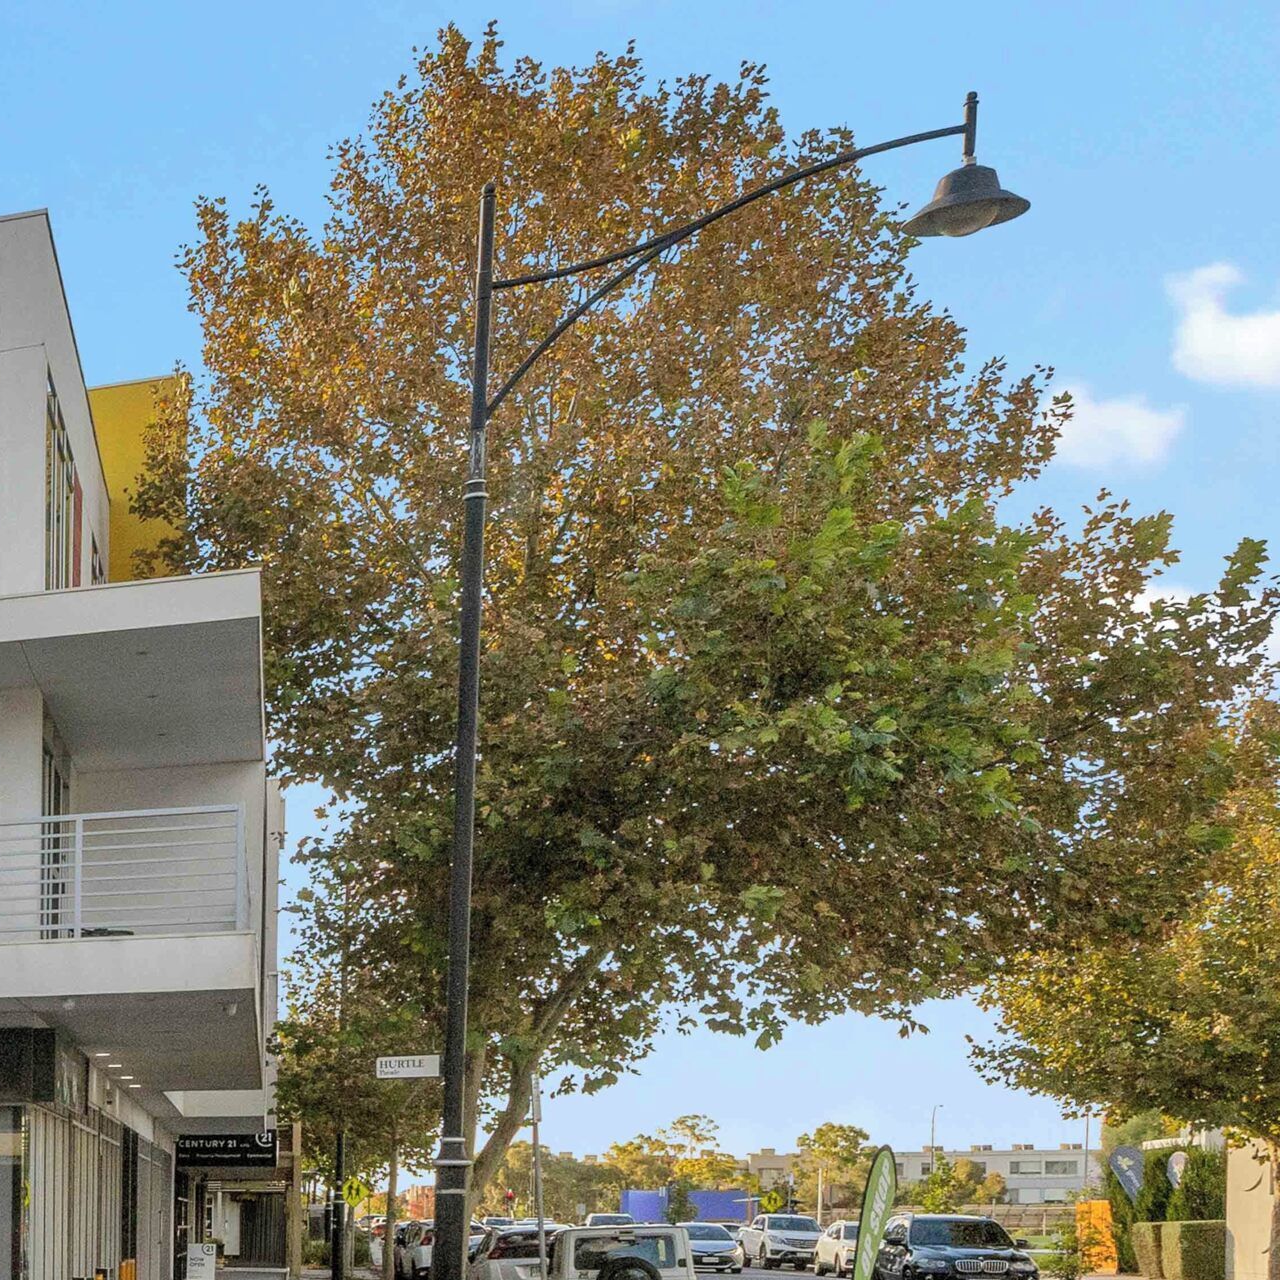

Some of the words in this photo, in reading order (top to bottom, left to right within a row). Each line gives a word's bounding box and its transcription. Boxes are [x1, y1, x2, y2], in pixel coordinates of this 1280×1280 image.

[380, 1059, 425, 1069] HURTLE
[260, 1132, 273, 1143] 21
[178, 1139, 227, 1148] CENTURY
[227, 1139, 237, 1148] 21
[861, 1233, 873, 1277] OP
[870, 1158, 891, 1235] SHOP
